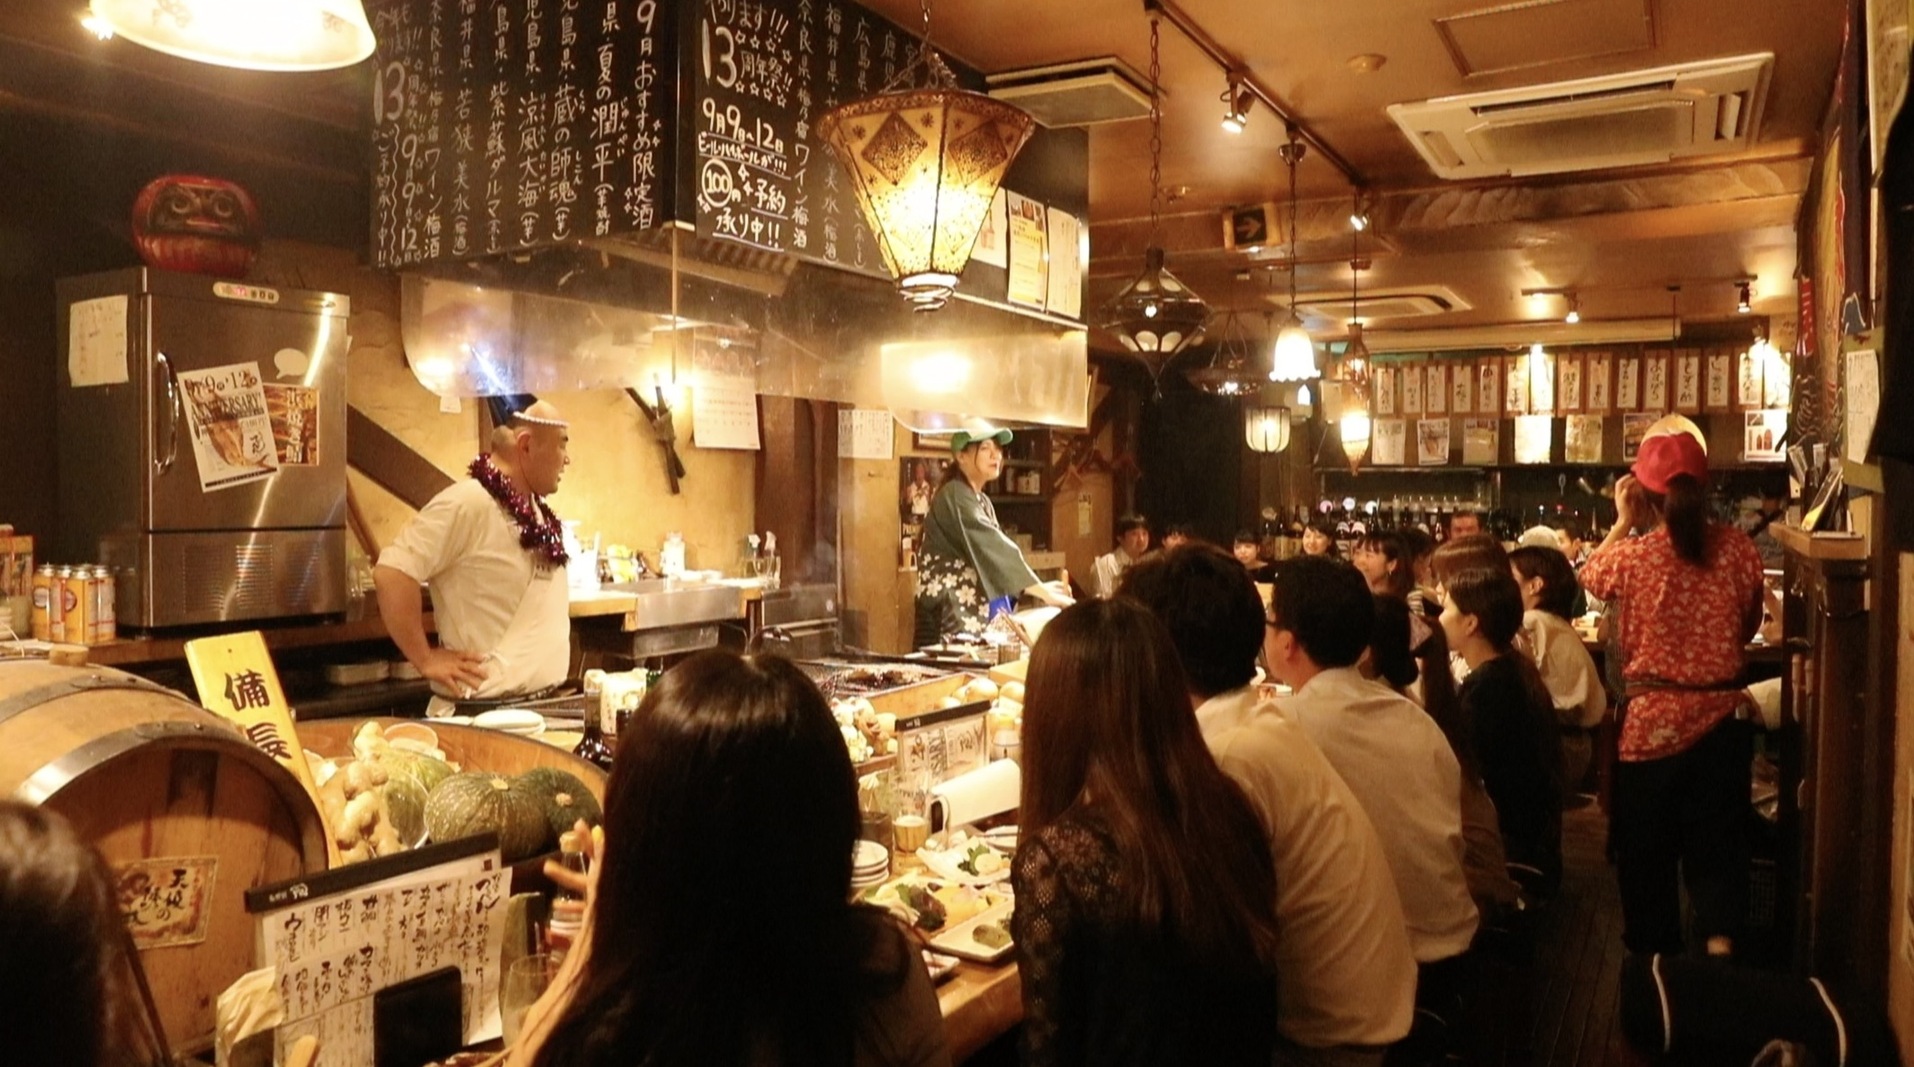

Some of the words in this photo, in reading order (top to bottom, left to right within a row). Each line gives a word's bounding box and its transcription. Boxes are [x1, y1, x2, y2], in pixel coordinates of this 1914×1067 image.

[632, 0, 658, 230] 9月おすすめ限定酒
[754, 178, 787, 215] 予約
